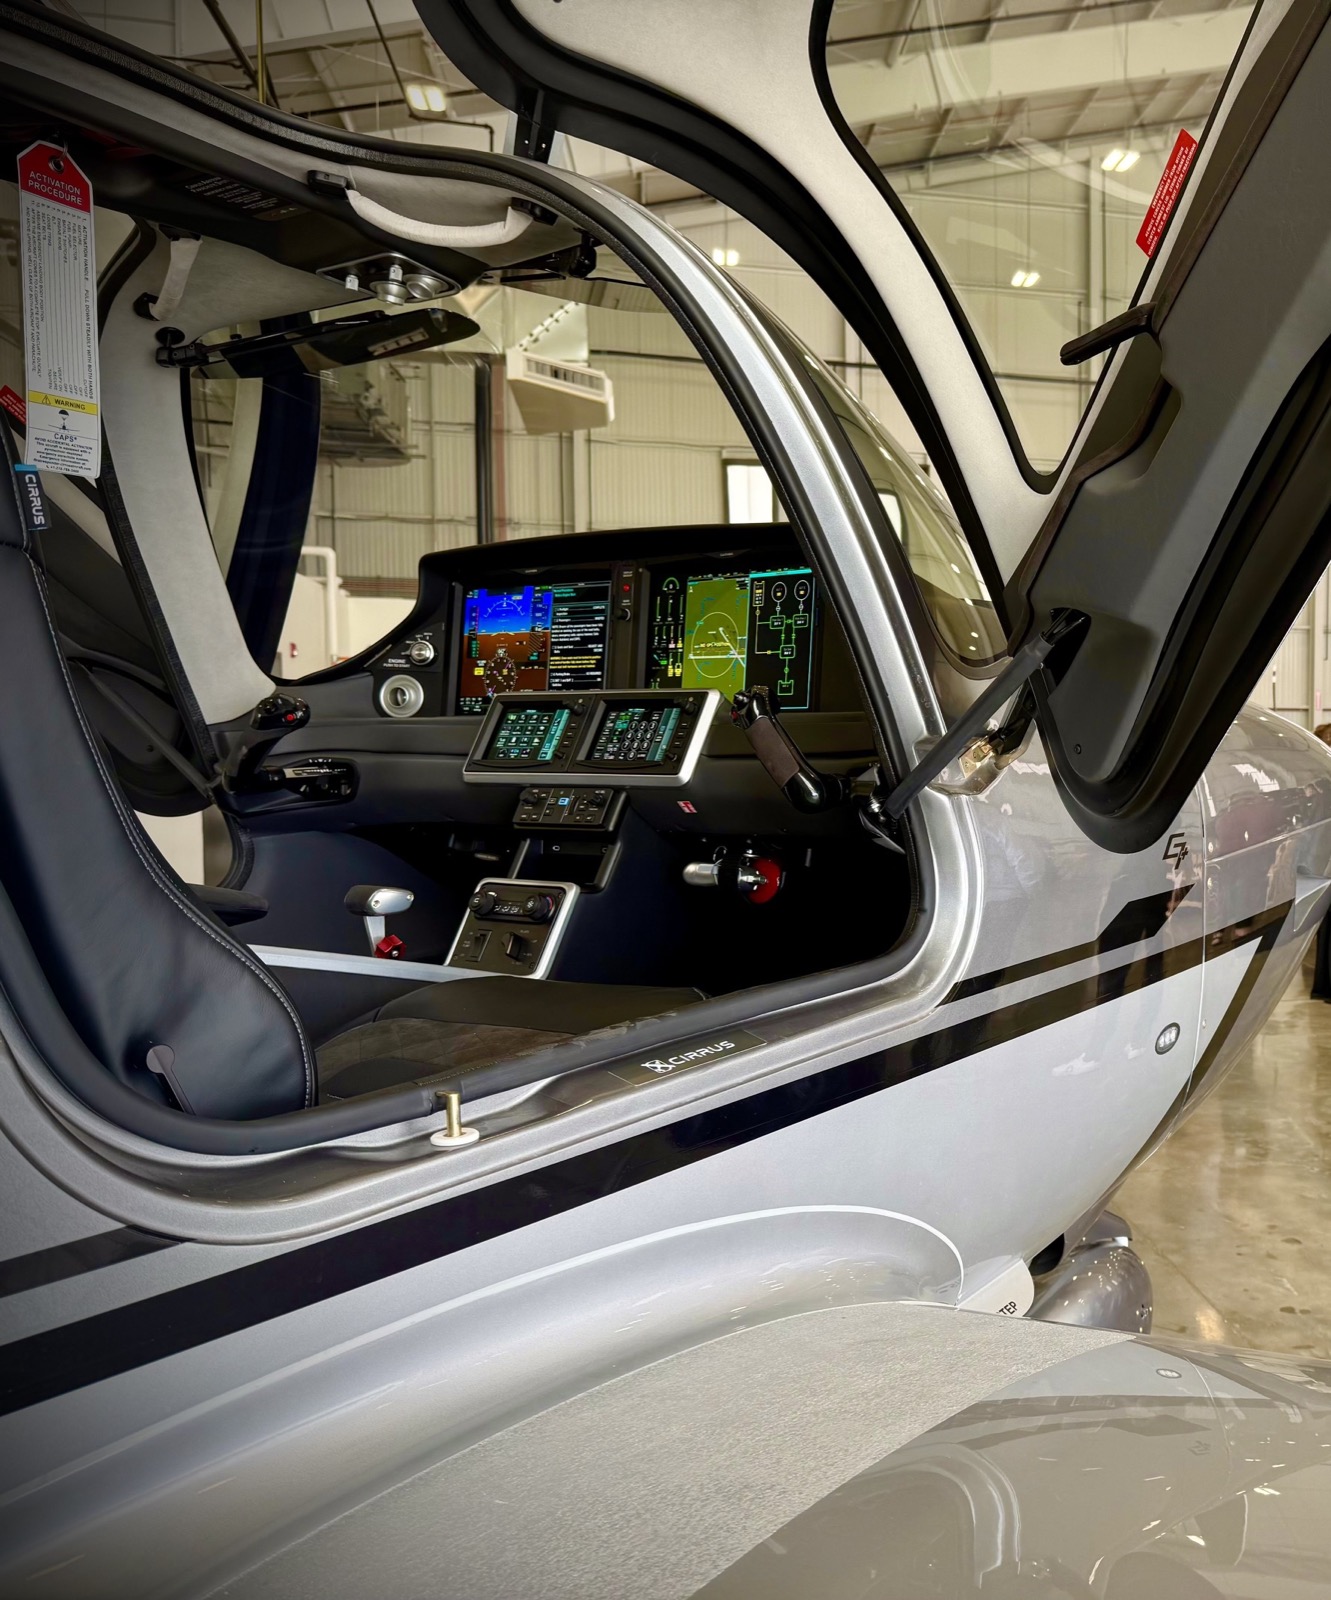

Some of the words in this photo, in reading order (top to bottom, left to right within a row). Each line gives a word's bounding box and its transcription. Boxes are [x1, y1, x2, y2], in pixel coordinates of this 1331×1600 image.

[28, 180, 82, 205] PROCEDURE
[30, 171, 80, 195] ACTIVATION
[54, 399, 86, 410] WARNING
[25, 474, 45, 525] CIRRUS
[668, 1041, 735, 1065] CIRRUS
[996, 1301, 1017, 1315] TEP
